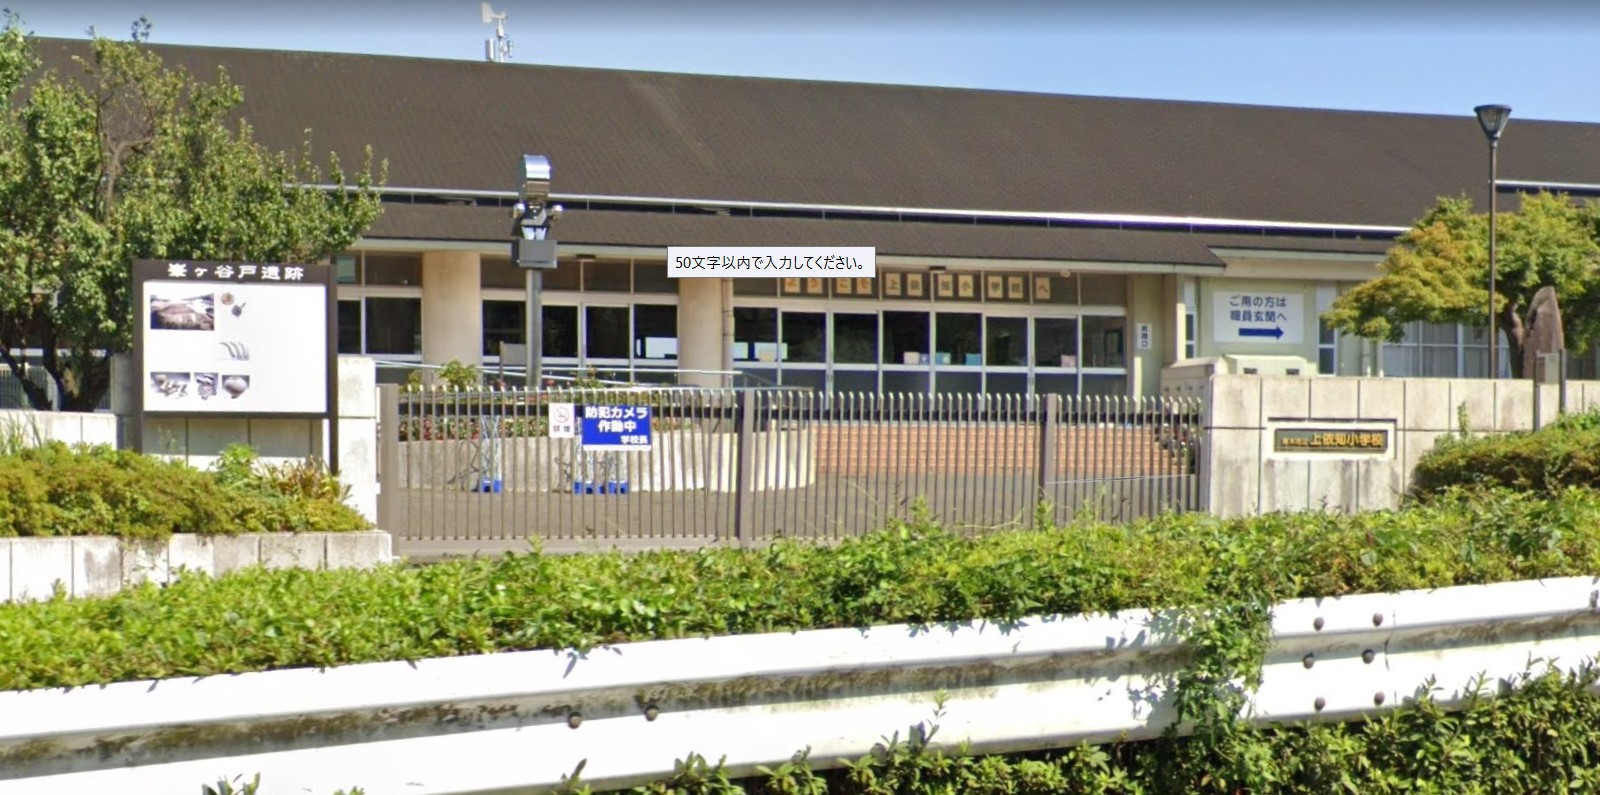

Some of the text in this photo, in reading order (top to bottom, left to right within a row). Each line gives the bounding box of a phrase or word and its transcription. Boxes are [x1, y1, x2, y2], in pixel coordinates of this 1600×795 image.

[1230, 295, 1287, 307] ご用の方は
[1230, 310, 1287, 322] 職員玄関へ
[585, 406, 648, 419] 防犯カメラ
[598, 420, 636, 432] 作動中
[621, 435, 648, 444] 学校長
[1311, 432, 1383, 447] 上依知小学校
